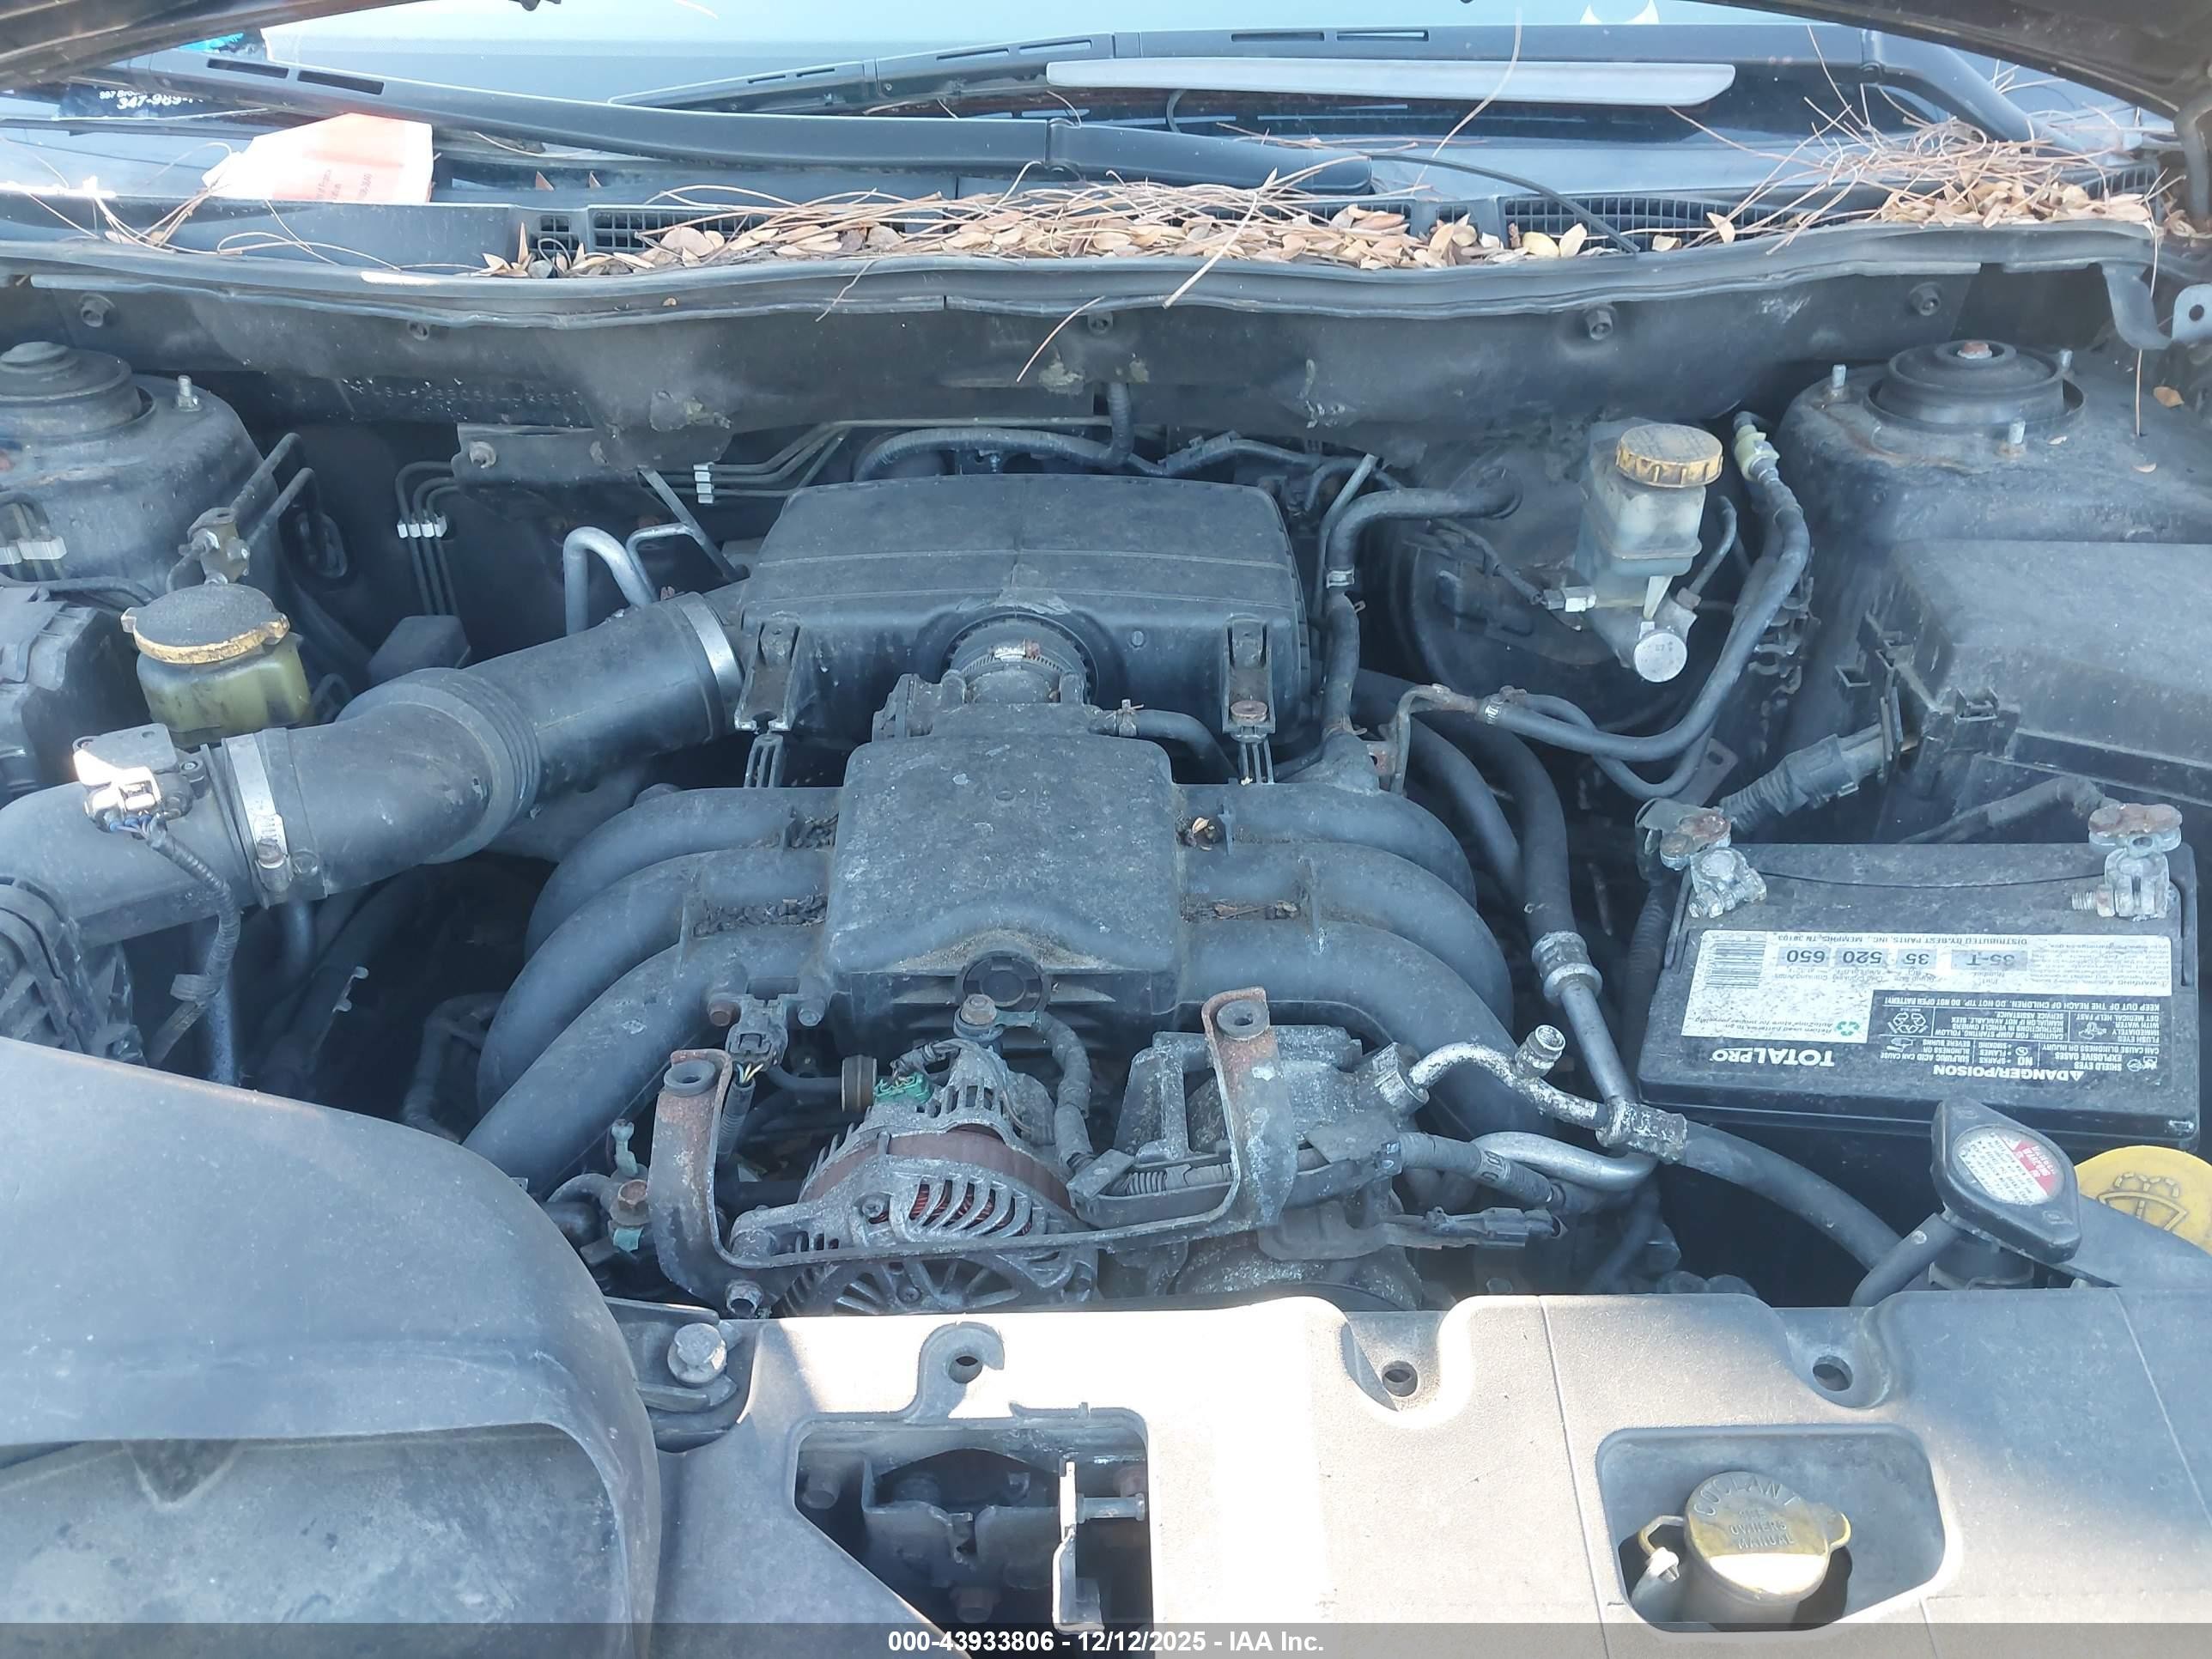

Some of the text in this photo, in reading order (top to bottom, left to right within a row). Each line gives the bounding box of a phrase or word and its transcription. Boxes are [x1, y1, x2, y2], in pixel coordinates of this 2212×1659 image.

[1786, 950, 1825, 963] 650
[1843, 951, 1882, 963] 520
[1904, 953, 1929, 965] 35
[1966, 955, 2014, 966] 35-T
[2051, 1001, 2062, 1010] OF
[2121, 1046, 2143, 1054] CAUSE
[2018, 1056, 2033, 1066] NO
[2055, 1052, 2080, 1060] GASES
[2075, 1061, 2122, 1072] SHIELD EYES
[1933, 1065, 2069, 1081] DANGER/POISON
[1693, 1475, 1802, 1516] COOLANT
[1737, 1532, 1796, 1550] MANUAL
